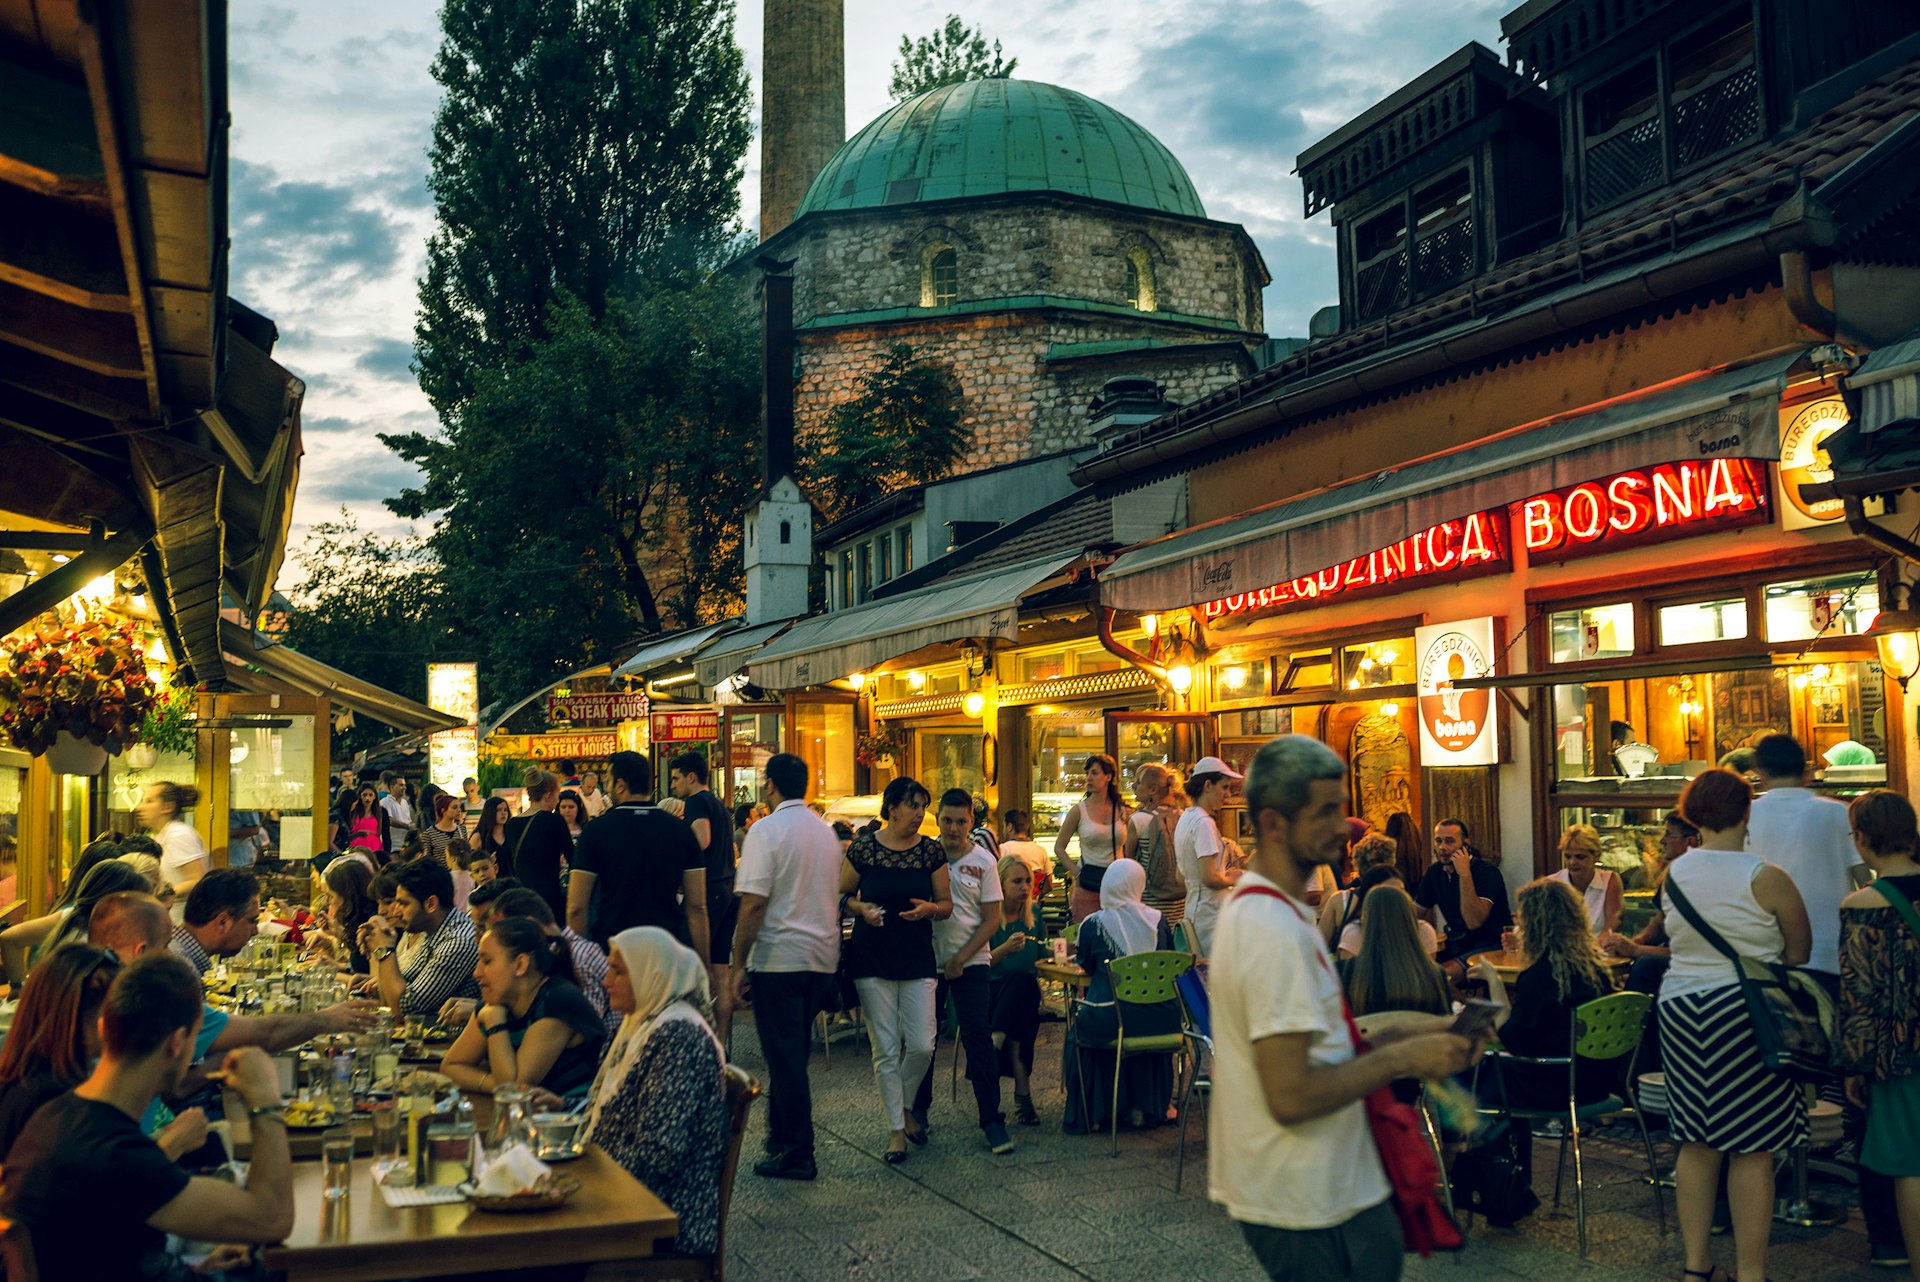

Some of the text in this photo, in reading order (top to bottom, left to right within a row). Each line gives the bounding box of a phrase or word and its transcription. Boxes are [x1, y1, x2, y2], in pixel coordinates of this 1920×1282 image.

[1699, 434, 1740, 455] bosna
[1523, 458, 1764, 553] BOSNA
[571, 702, 650, 720] STEAK HOUSE
[672, 726, 718, 738] DRAFT BEER
[1434, 718, 1477, 739] bosna
[547, 742, 616, 758] STEAK HOUSE
